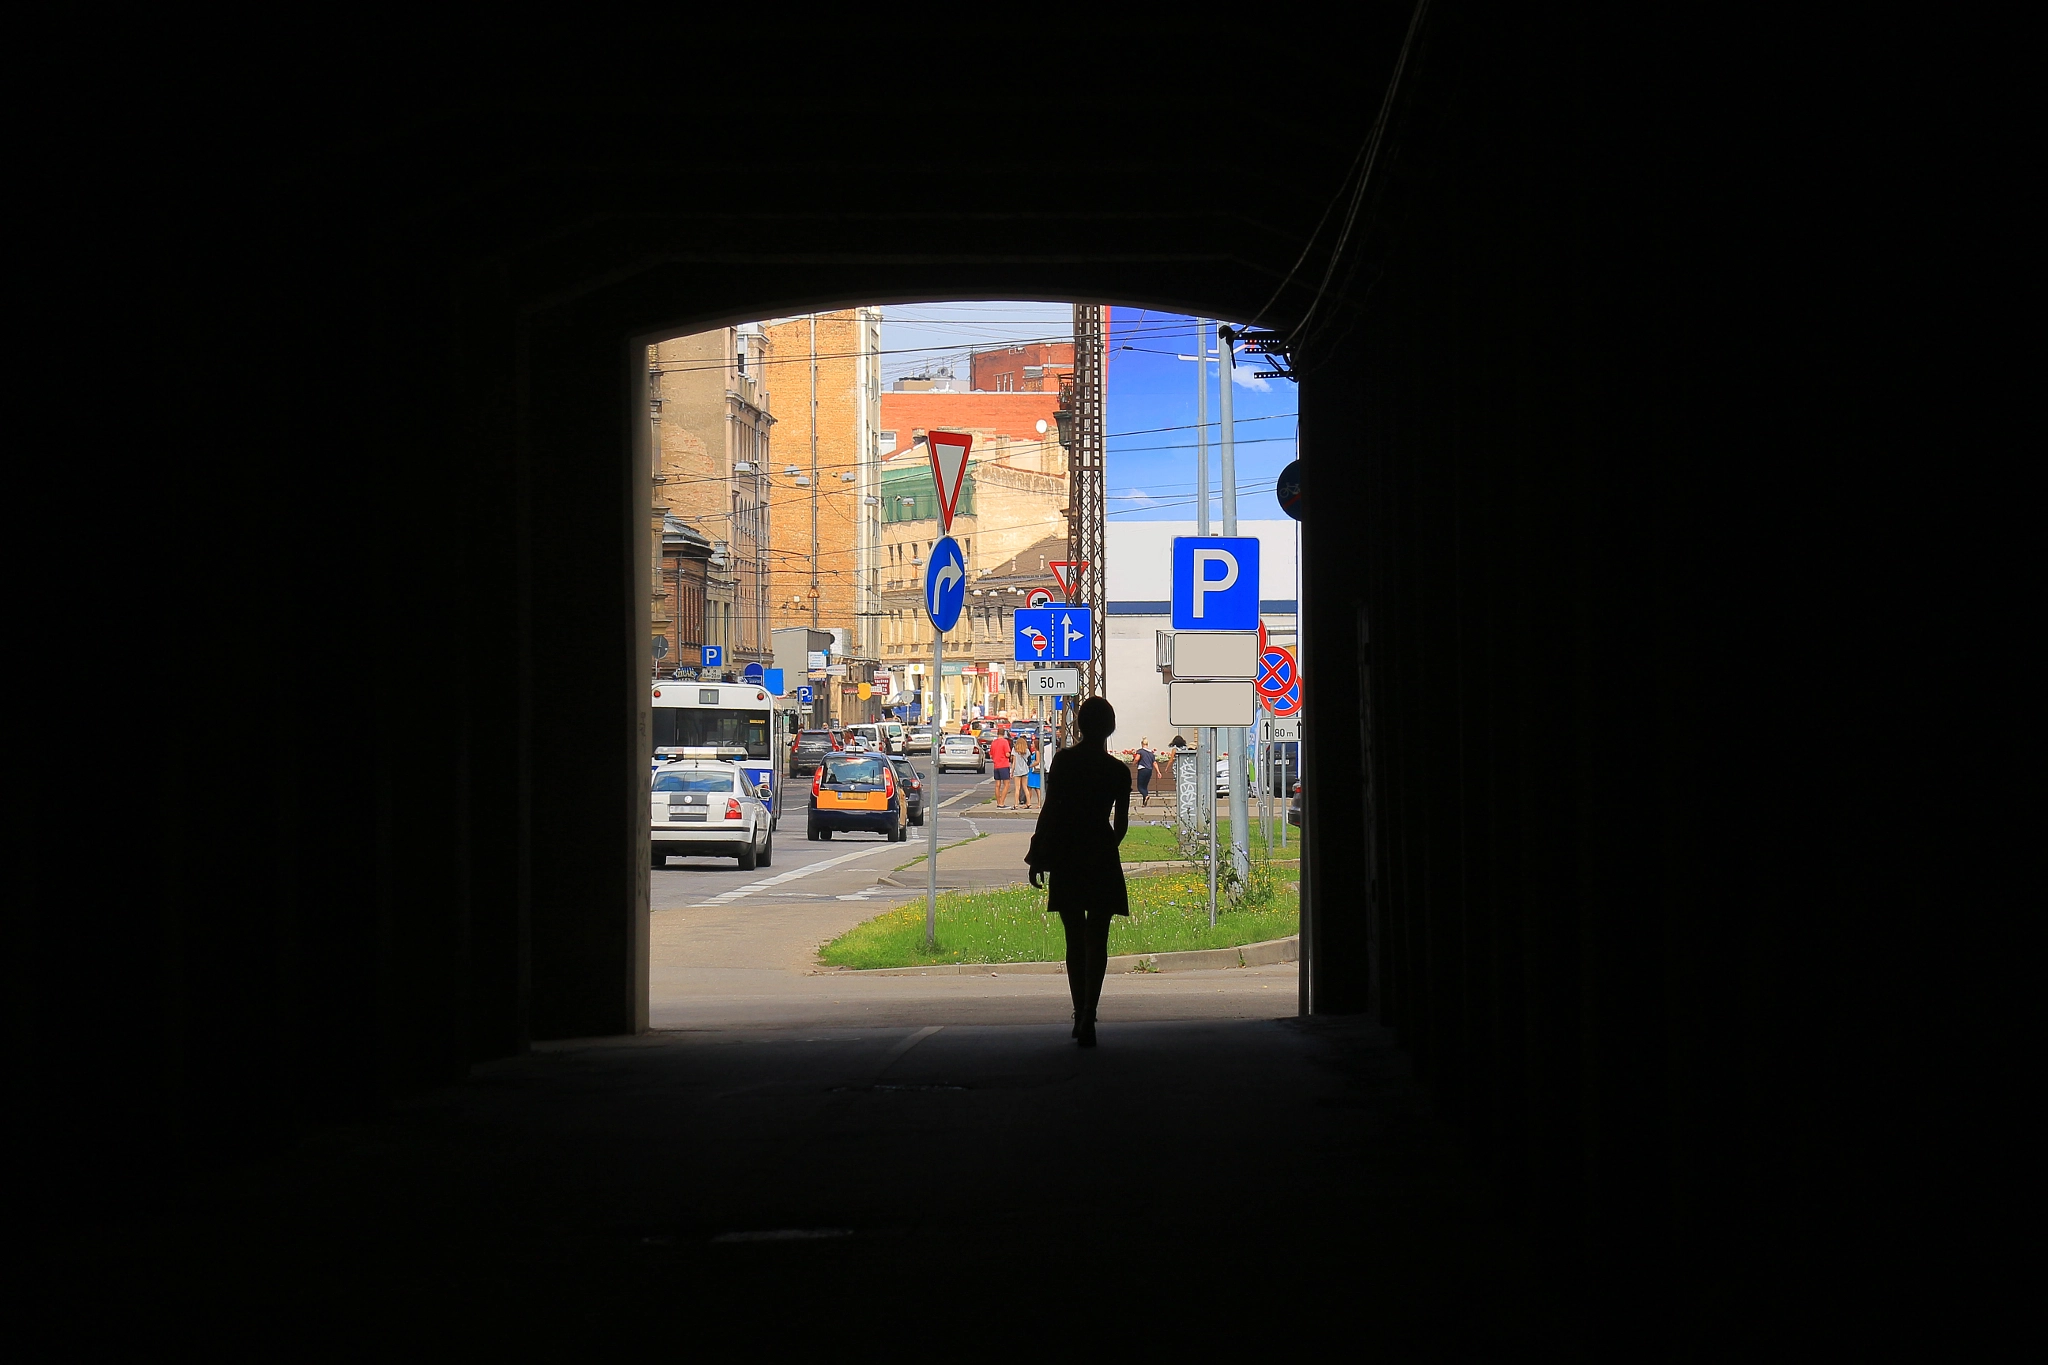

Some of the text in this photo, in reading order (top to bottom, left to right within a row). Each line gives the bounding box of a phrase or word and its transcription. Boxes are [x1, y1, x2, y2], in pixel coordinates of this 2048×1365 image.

[1193, 549, 1239, 618] P
[706, 649, 717, 664] P
[1040, 677, 1054, 688] 50
[801, 688, 809, 700] P
[1275, 729, 1285, 737] 80
